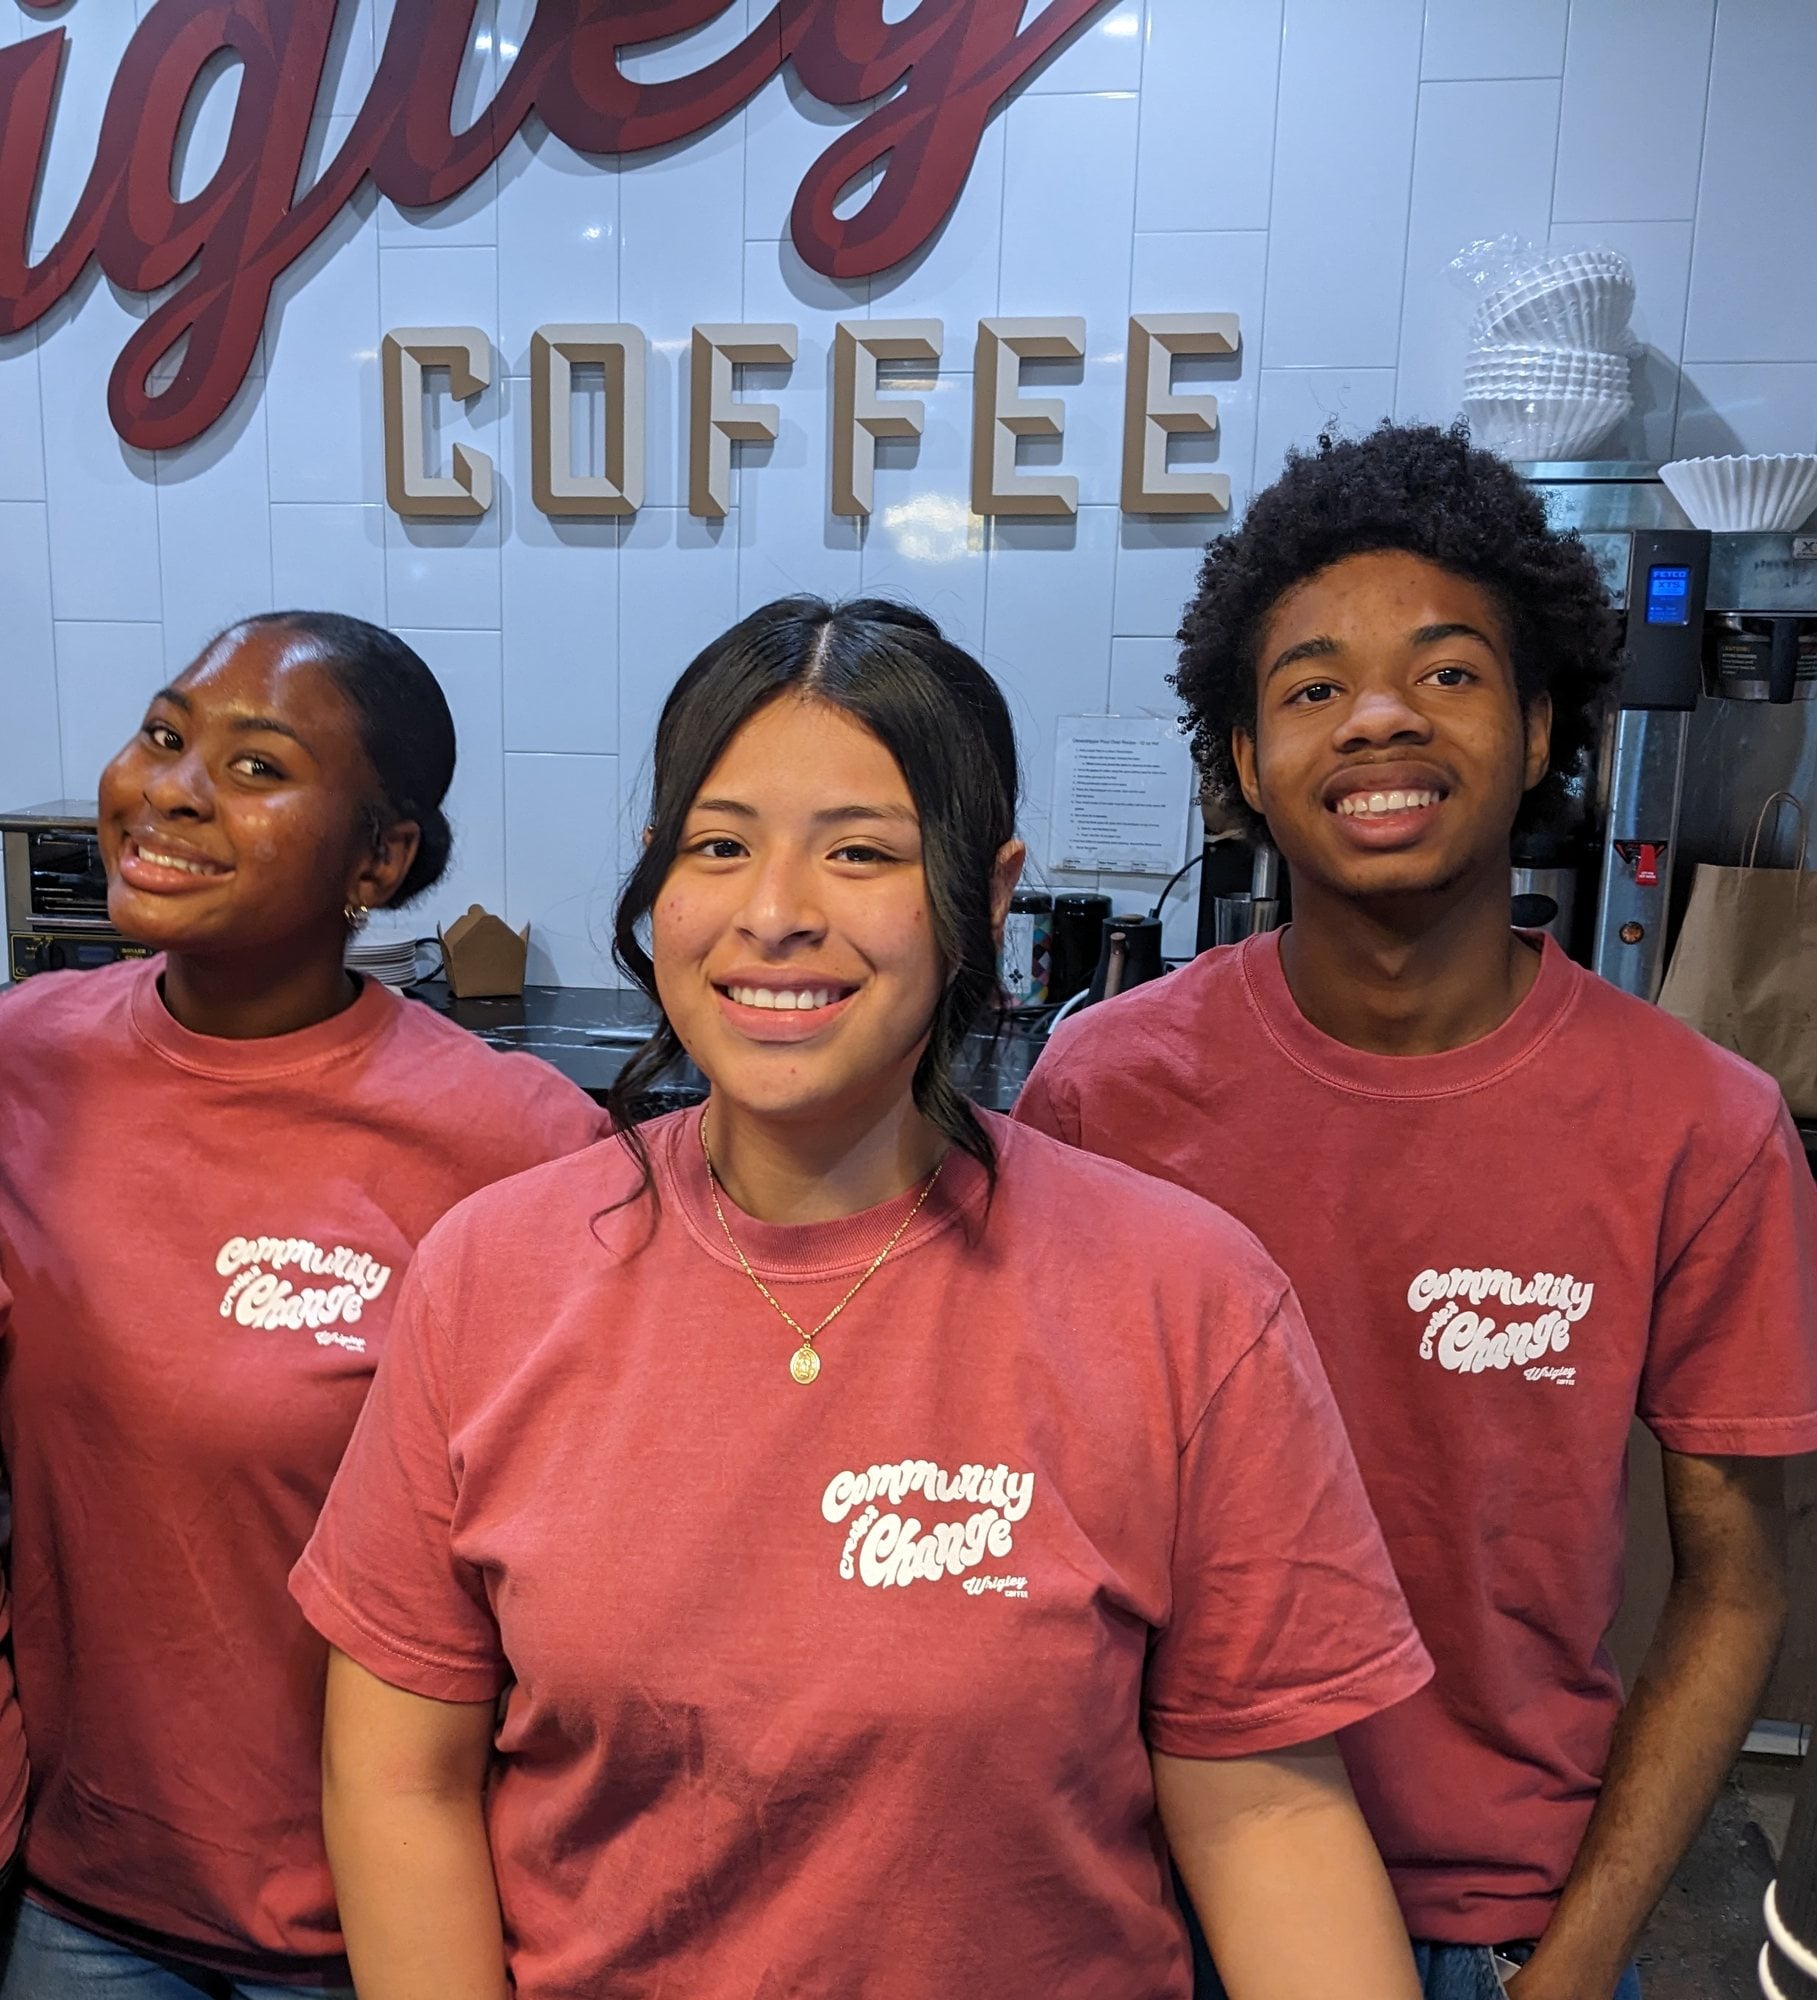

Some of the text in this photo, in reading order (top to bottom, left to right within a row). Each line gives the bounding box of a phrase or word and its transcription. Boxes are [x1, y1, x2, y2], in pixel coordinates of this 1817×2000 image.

[381, 313, 1240, 517] COFFEE
[216, 1236, 391, 1300] Community
[1407, 1267, 1595, 1322] Community
[235, 1273, 364, 1331] Change
[1419, 1300, 1459, 1360] creates
[1438, 1310, 1570, 1374] Change
[1523, 1366, 1577, 1381] Wrigley
[821, 1459, 1035, 1523] Community
[839, 1504, 880, 1580] creates
[859, 1508, 1013, 1589] Change
[962, 1575, 1029, 1596] Wrigley
